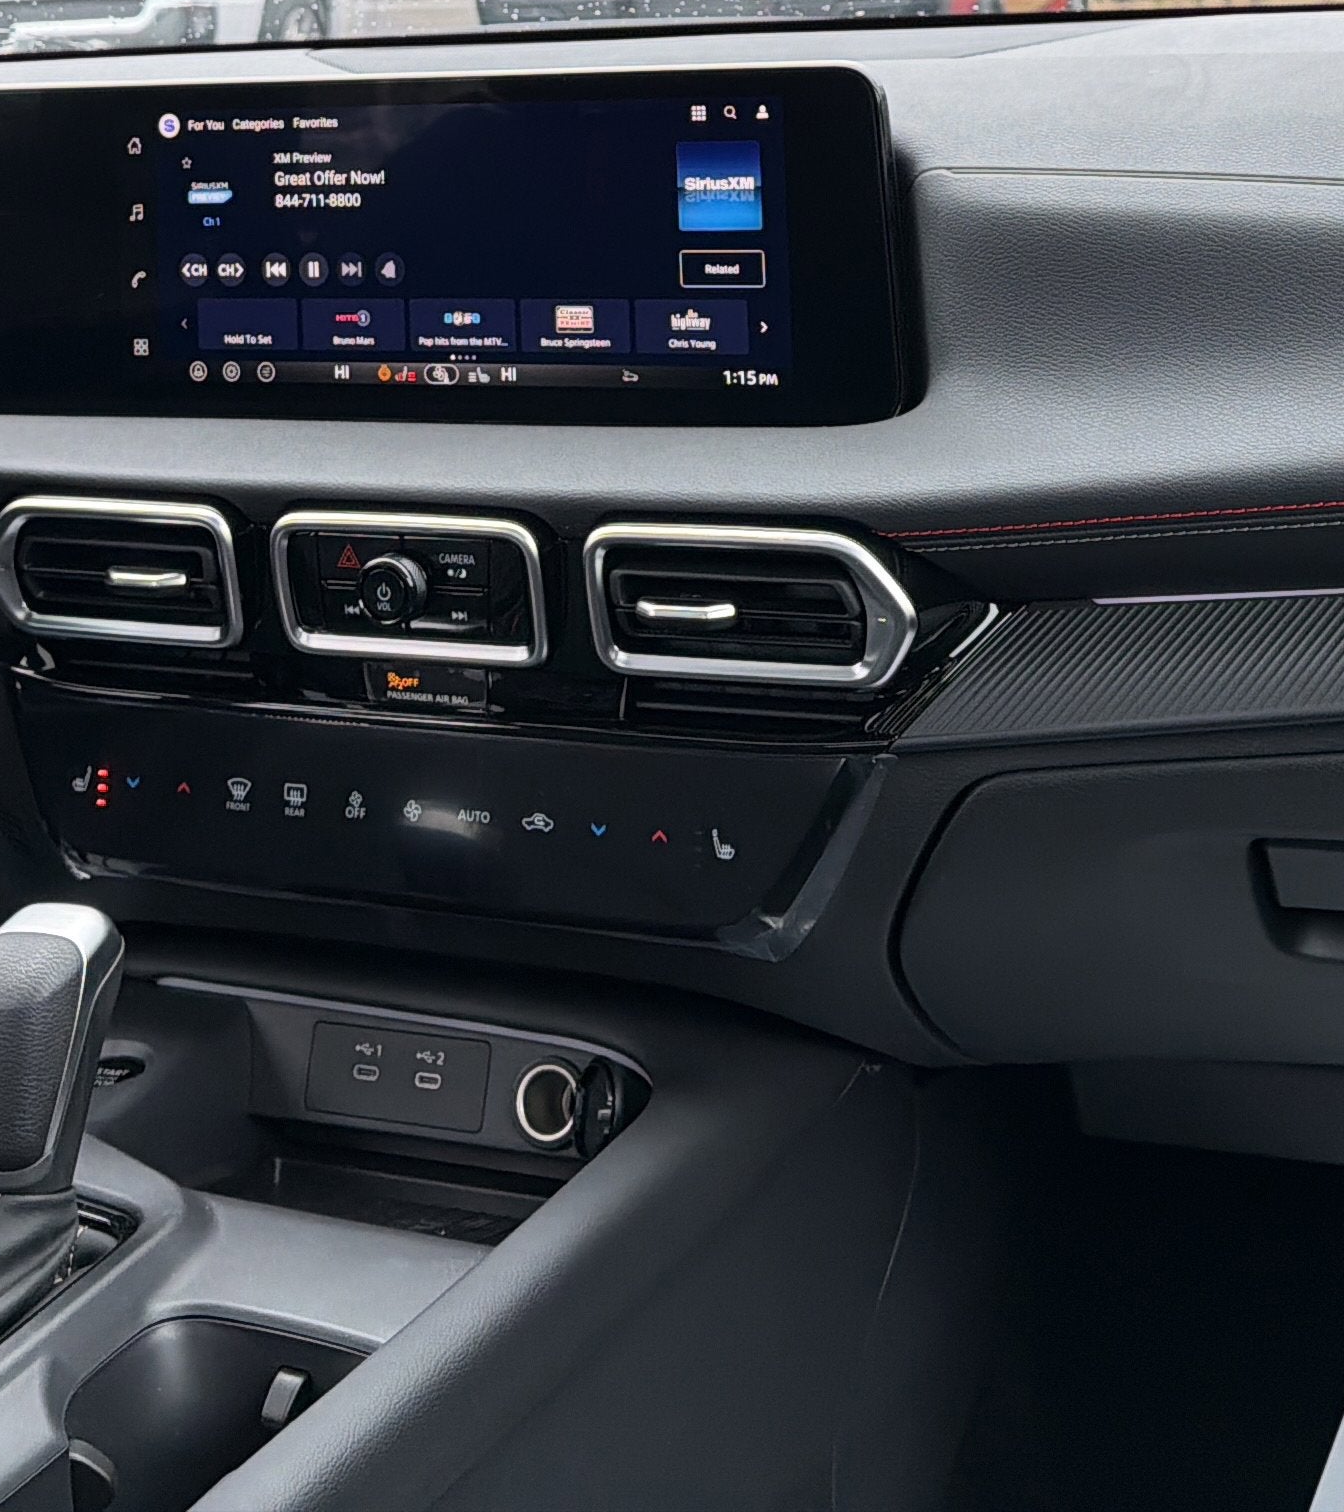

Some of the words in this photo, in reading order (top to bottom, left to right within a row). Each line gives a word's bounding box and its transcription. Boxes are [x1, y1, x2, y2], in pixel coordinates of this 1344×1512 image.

[187, 120, 206, 131] For
[206, 119, 224, 131] You
[232, 118, 285, 132] Categories
[292, 117, 338, 129] Favorites
[273, 152, 291, 164] XM
[292, 152, 332, 164] Preview
[274, 171, 311, 186] Great
[314, 170, 347, 186] Offer
[349, 170, 385, 185] Now!
[684, 176, 755, 191] SiriusXM
[274, 192, 361, 208] 844-711-8800
[203, 216, 215, 226] Ch
[704, 264, 740, 275] Related
[670, 314, 711, 331] highway
[224, 334, 244, 345] Hold
[245, 334, 256, 345] To
[257, 334, 273, 345] Set
[332, 335, 355, 345] Bruno
[356, 336, 375, 345] Mars
[418, 336, 433, 347] Pop
[434, 336, 449, 346] hits
[450, 336, 468, 346] from
[469, 336, 482, 346] the
[540, 338, 563, 348] Bruce
[564, 338, 611, 349] Springsteen
[668, 338, 689, 349] Chris
[690, 339, 717, 350] Young
[334, 365, 350, 380] HI
[500, 367, 517, 382] HI
[722, 370, 757, 386] 1:15
[758, 374, 778, 386] PM
[438, 553, 475, 565] CAMERA
[377, 602, 392, 612] VOL
[402, 678, 420, 688] OFF
[387, 691, 433, 702] PASSENGER
[435, 693, 450, 703] AIR
[451, 695, 469, 705] BAG
[225, 801, 251, 812] FRONT
[284, 806, 305, 817] REAR
[345, 806, 366, 819] OFF
[457, 808, 490, 824] AUTO
[436, 1052, 445, 1065] 2
